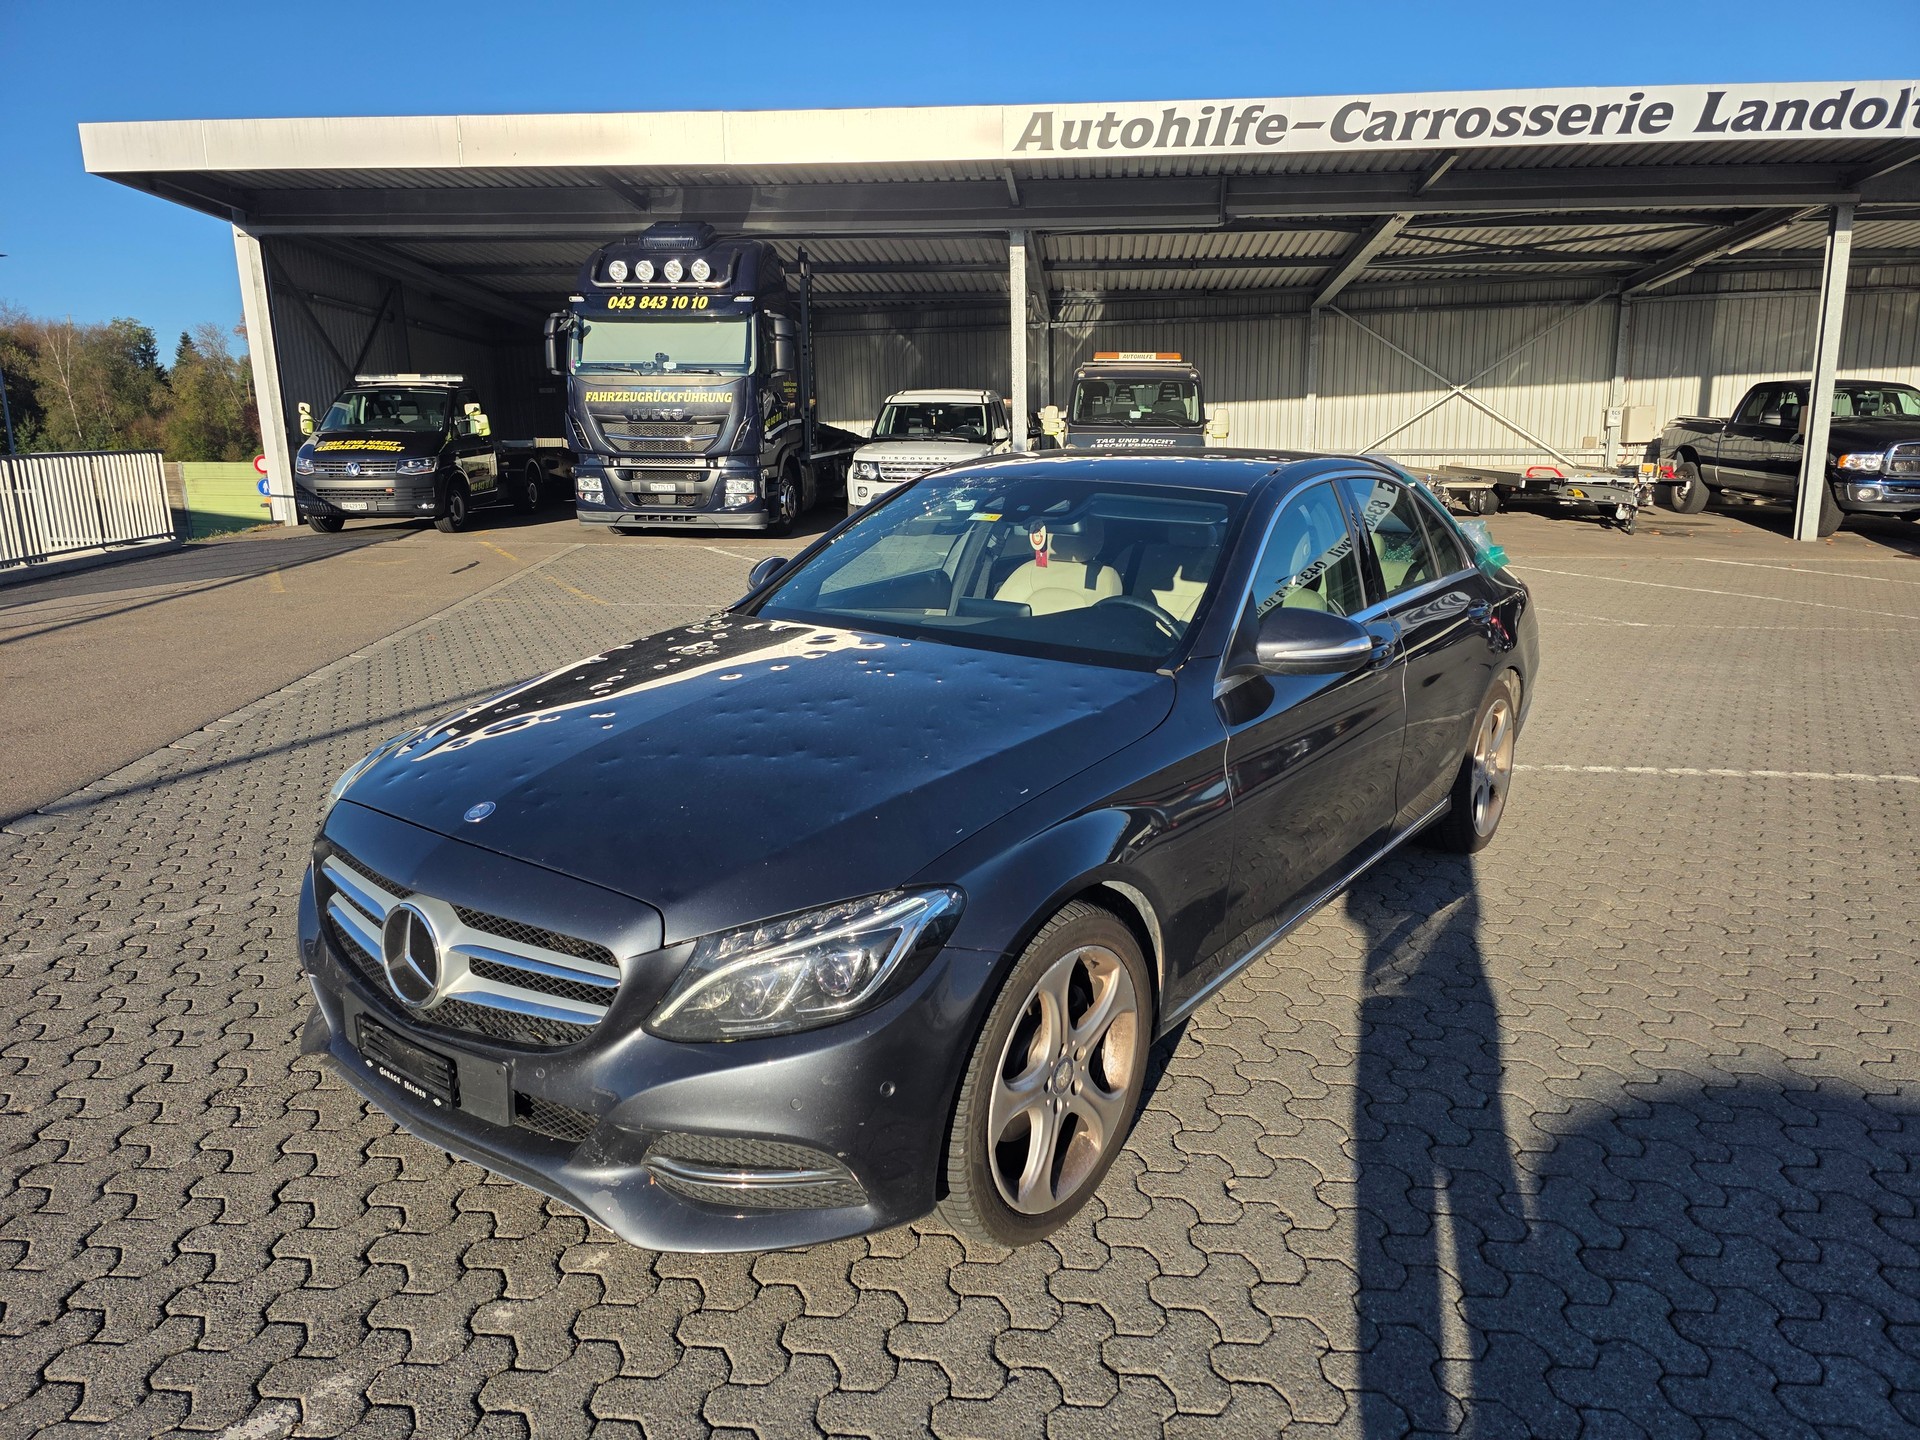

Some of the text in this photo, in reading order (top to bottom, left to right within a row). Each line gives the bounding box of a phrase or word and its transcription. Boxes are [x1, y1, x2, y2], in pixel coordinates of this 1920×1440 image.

[607, 296, 709, 309] 043 843 10 10
[585, 389, 733, 403] FAHRZEUGRÜCKFÜHRUNG
[379, 1066, 427, 1099] GARAGE HALDEN
